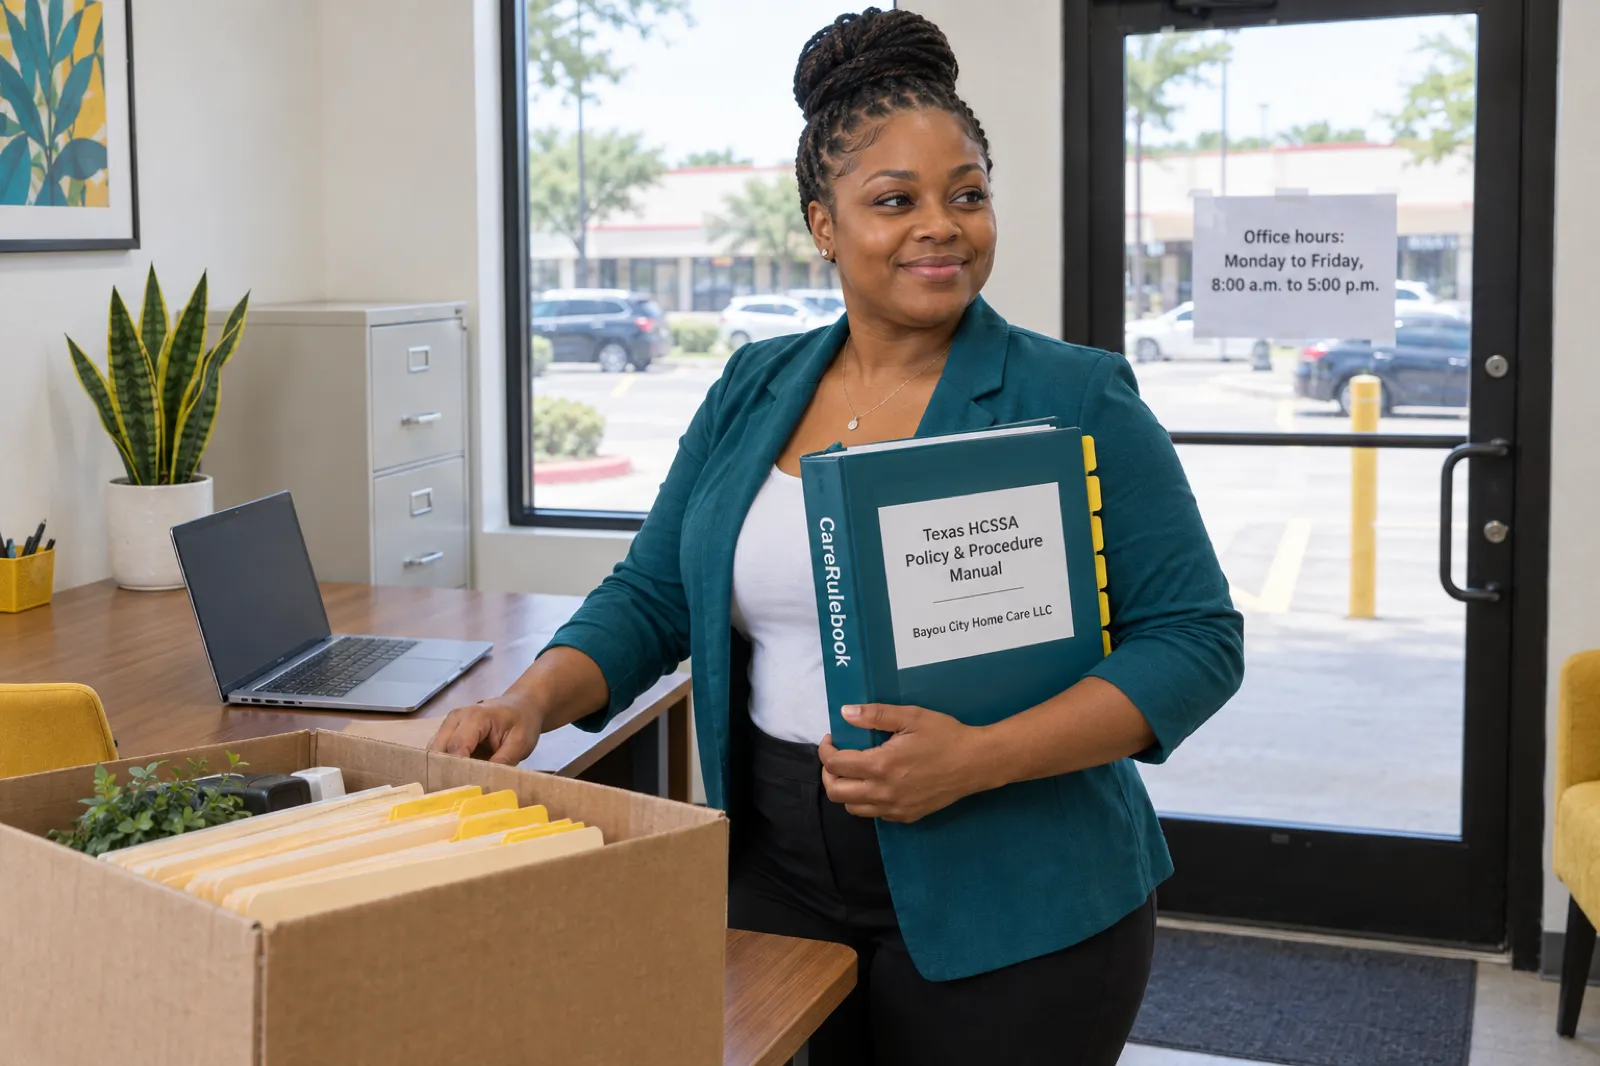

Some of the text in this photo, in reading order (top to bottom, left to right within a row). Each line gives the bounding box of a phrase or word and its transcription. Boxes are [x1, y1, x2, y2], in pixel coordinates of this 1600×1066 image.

[1244, 229, 1344, 243] Office hours:
[1224, 253, 1364, 271] Monday to Friday,
[1211, 278, 1379, 294] 8:00 a.m. to 5:00 p.m.
[923, 515, 1019, 542] Texas HCSSA
[905, 535, 1043, 567] Policy & Procedure
[949, 561, 1003, 583] Manual
[819, 517, 850, 667] CareRulebook
[912, 604, 1053, 638] Bayou City Home Care LLC
